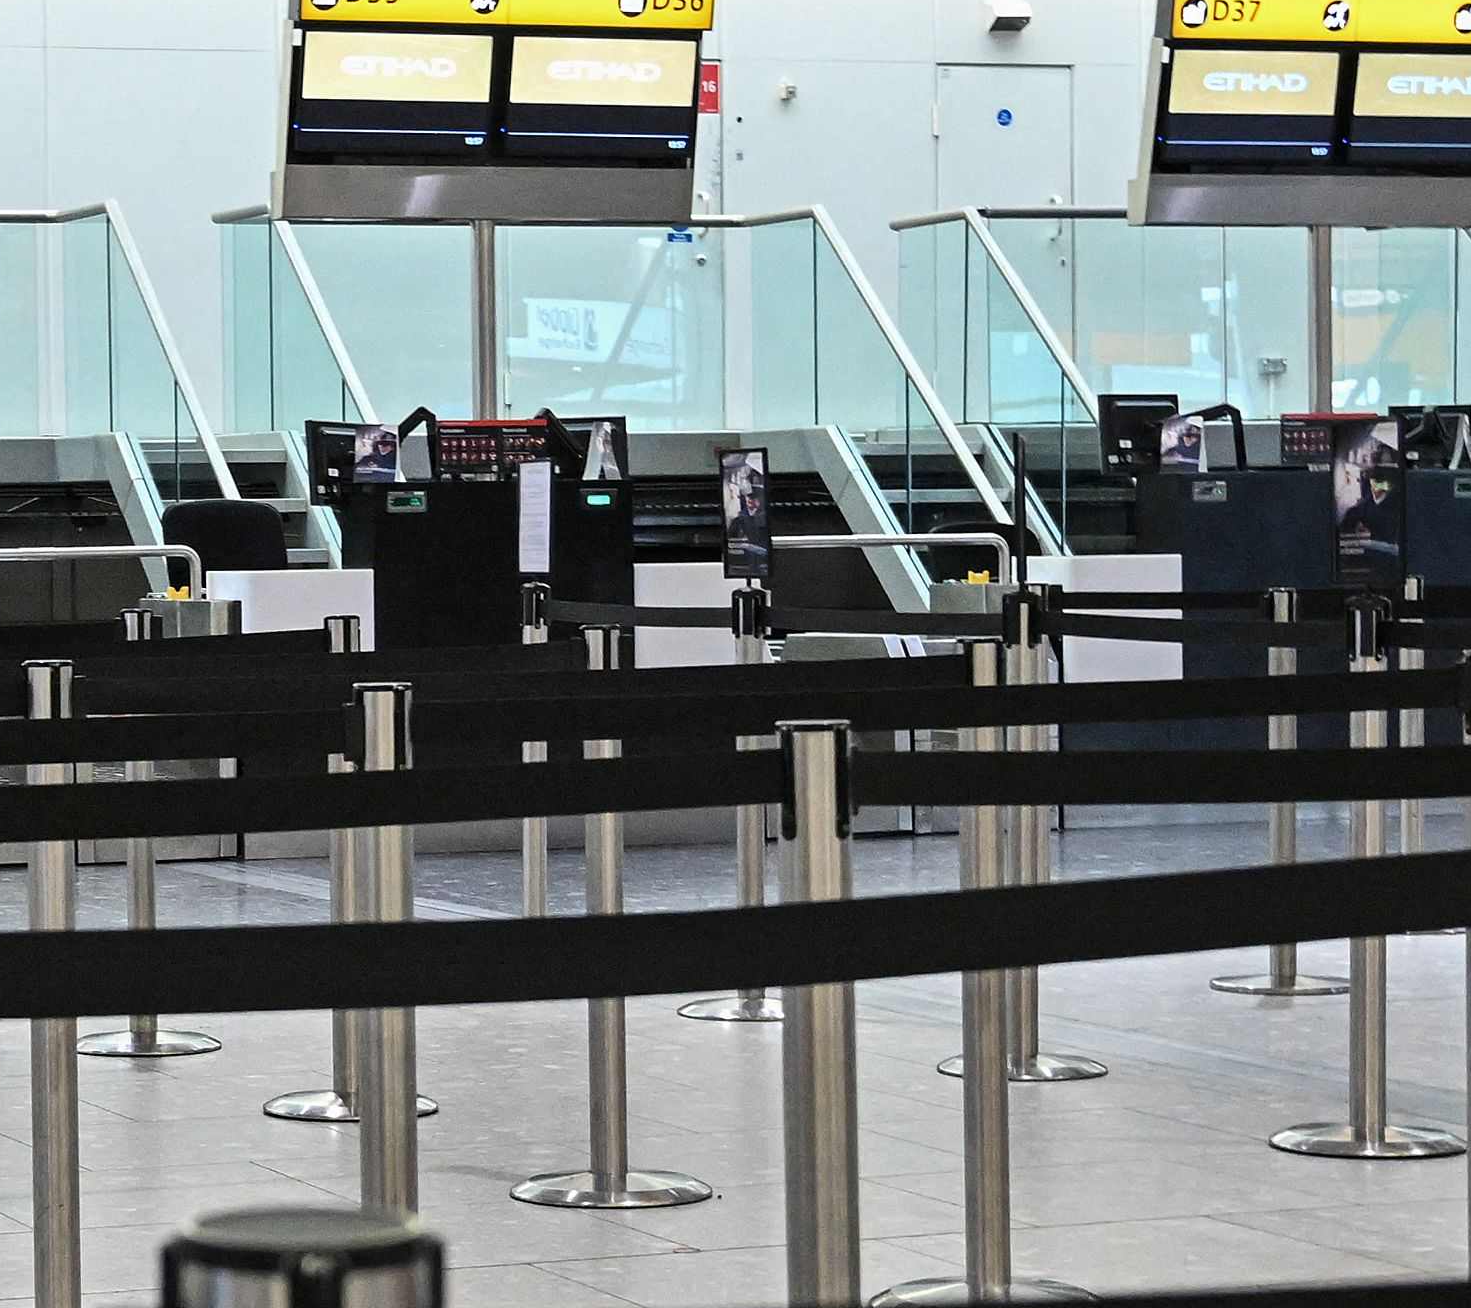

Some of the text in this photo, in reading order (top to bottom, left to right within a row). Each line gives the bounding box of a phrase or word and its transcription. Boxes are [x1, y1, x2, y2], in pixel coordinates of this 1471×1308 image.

[1212, 0, 1261, 23] D37
[340, 56, 456, 78] ETIHAD
[547, 59, 662, 82] ETIHAD
[1203, 71, 1307, 93] ETIHAD
